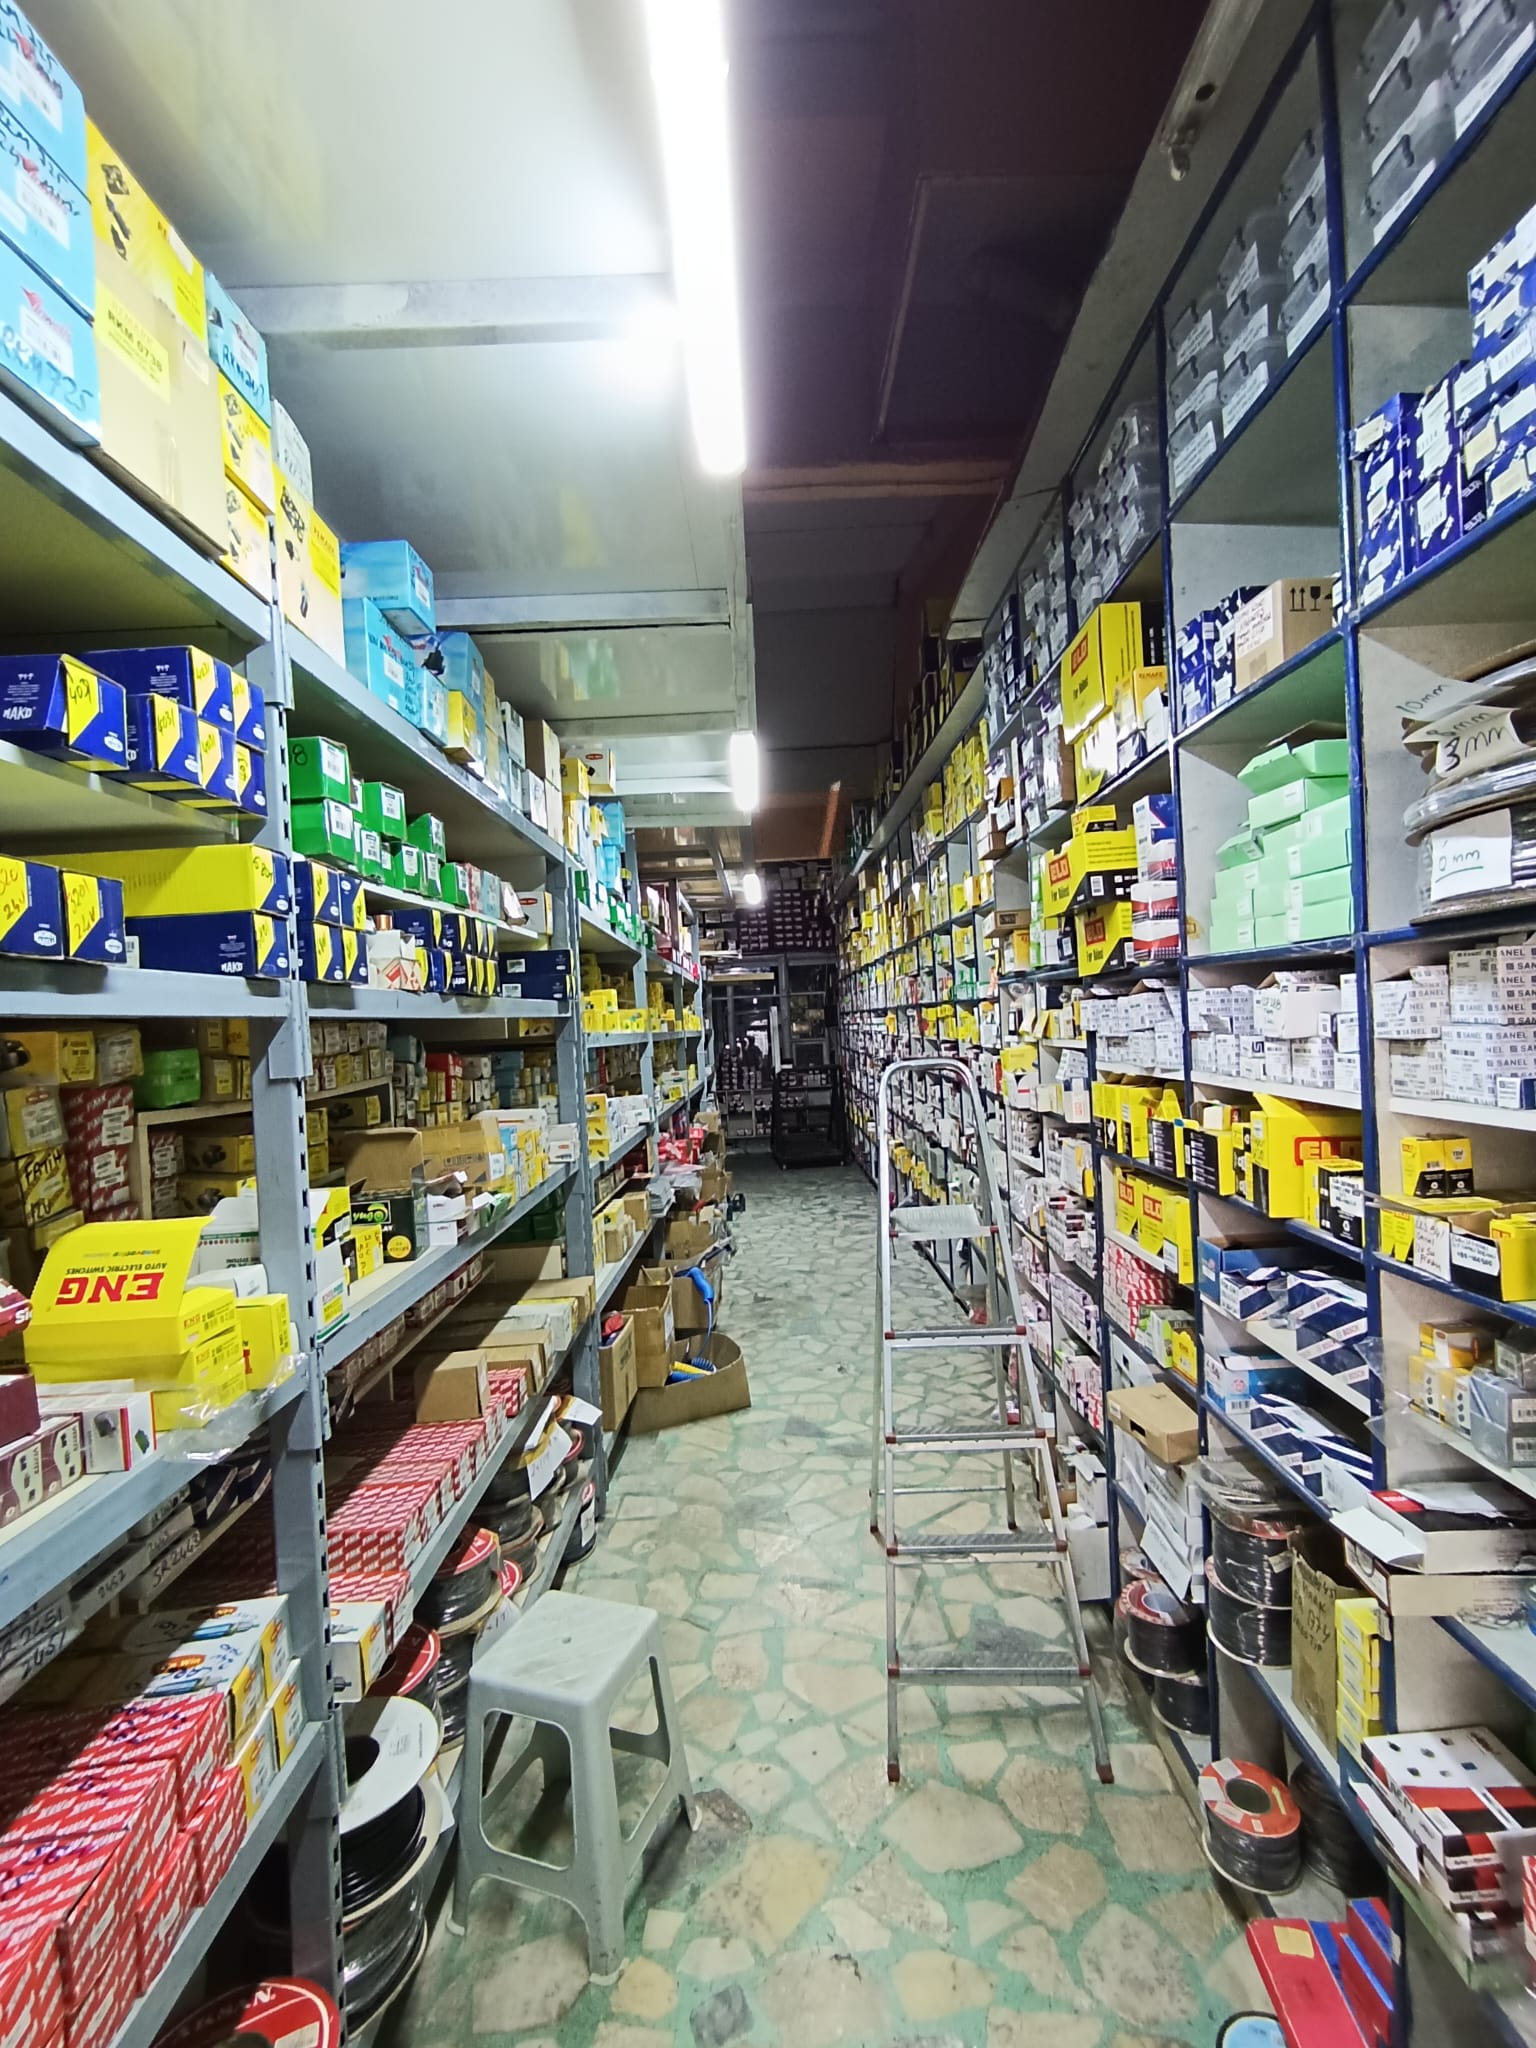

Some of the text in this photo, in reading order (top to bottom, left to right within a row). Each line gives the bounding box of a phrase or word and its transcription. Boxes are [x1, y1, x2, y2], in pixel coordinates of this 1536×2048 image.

[65, 1262, 168, 1276] AUTO ELECTRIC SWITCHES
[55, 1272, 164, 1305] ENG
